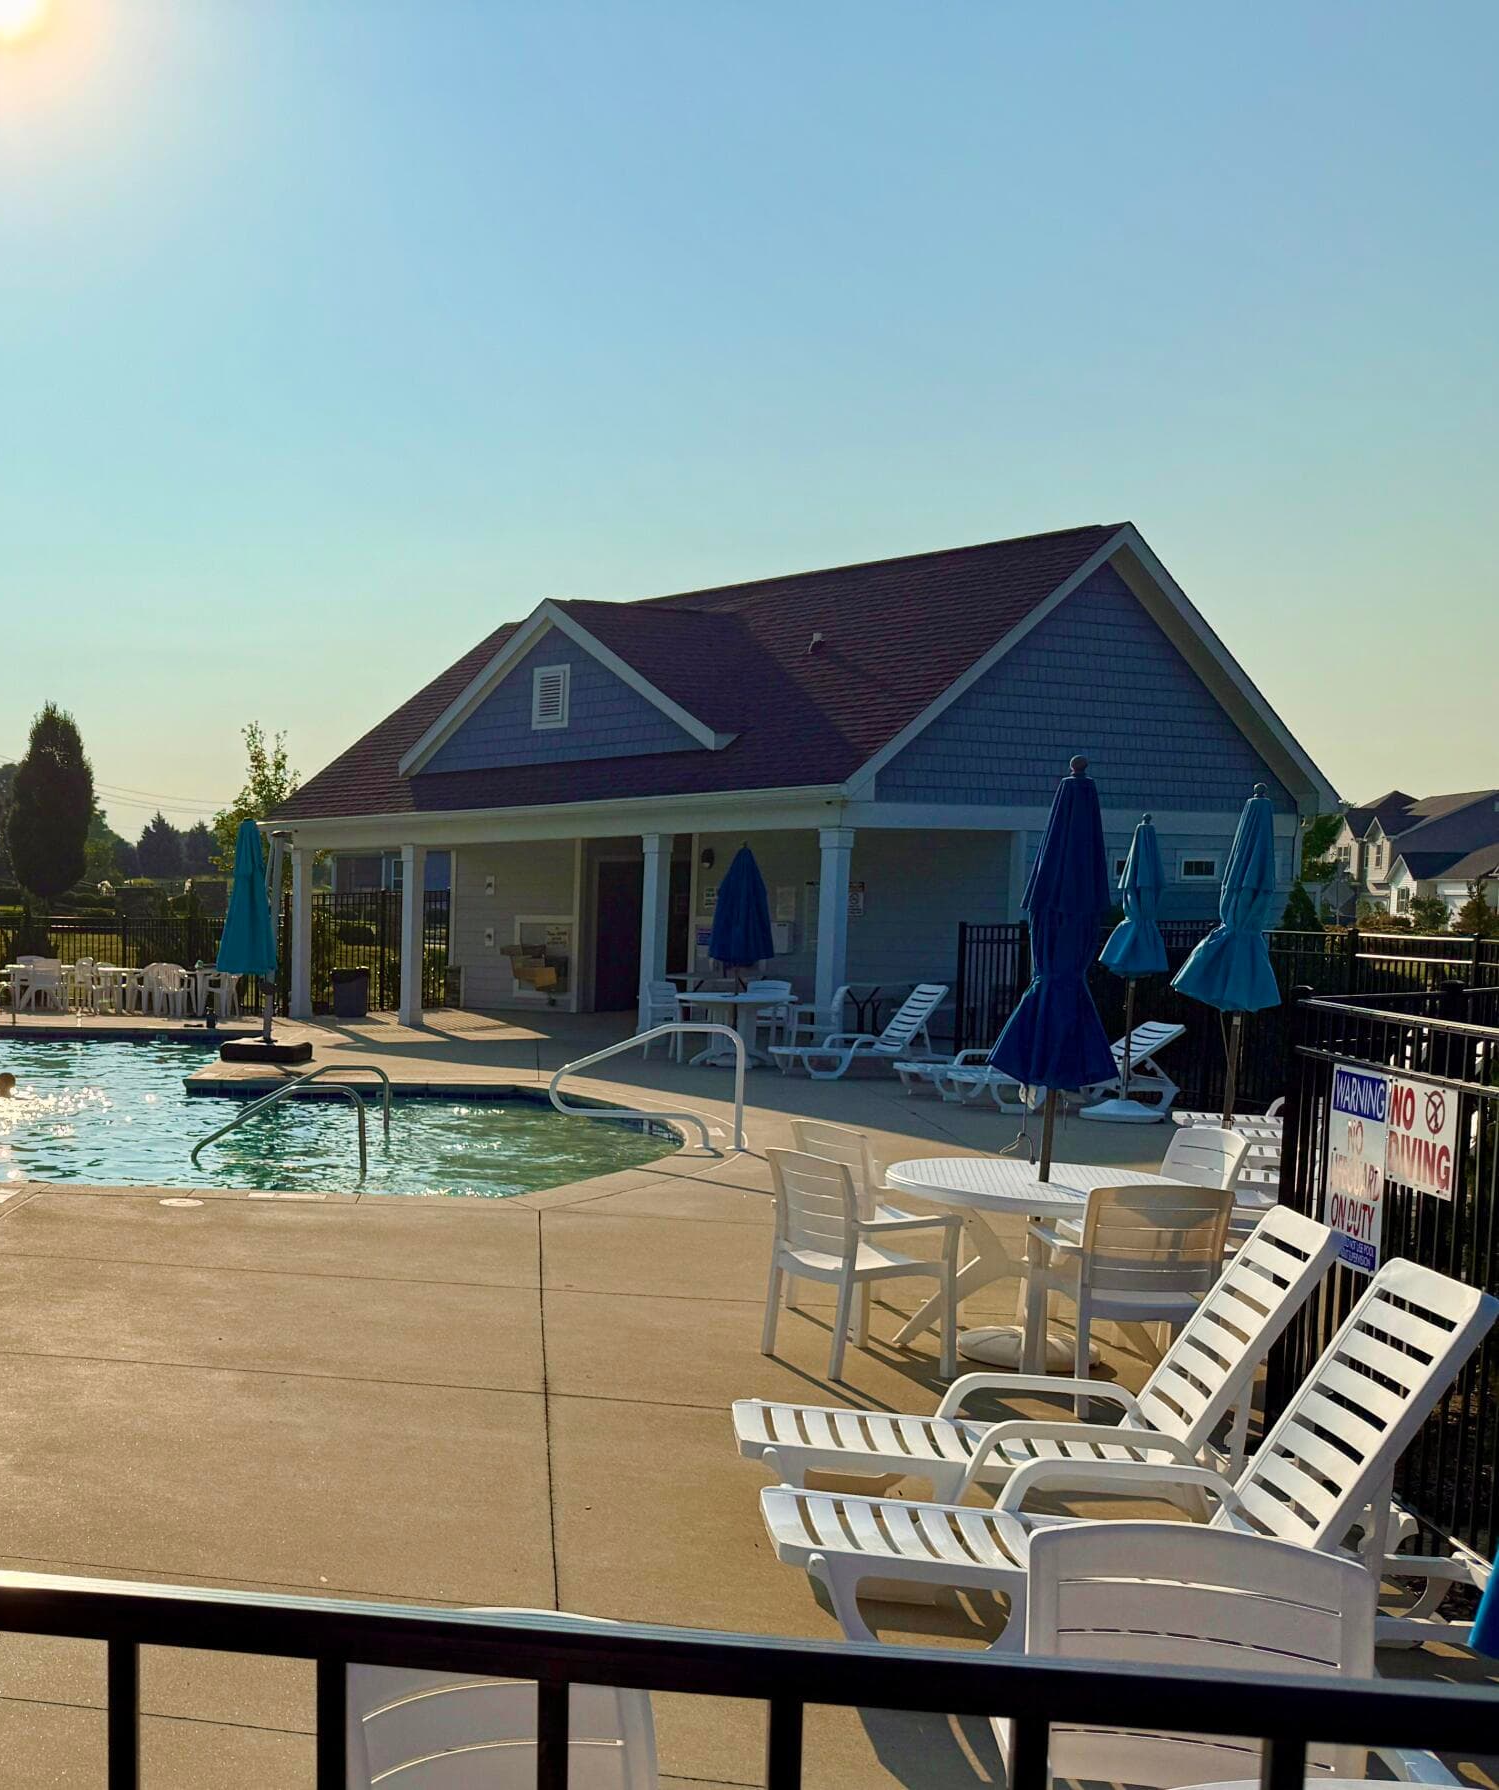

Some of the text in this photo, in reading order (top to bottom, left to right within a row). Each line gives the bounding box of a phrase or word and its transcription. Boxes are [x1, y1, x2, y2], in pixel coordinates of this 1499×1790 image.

[1336, 1073, 1386, 1119] WARNING
[1390, 1084, 1415, 1131] NO
[1348, 1120, 1364, 1155] NO
[1387, 1130, 1451, 1190] DIVING
[1331, 1152, 1380, 1202] LIFUARD
[1331, 1193, 1375, 1240] ON DUTY
